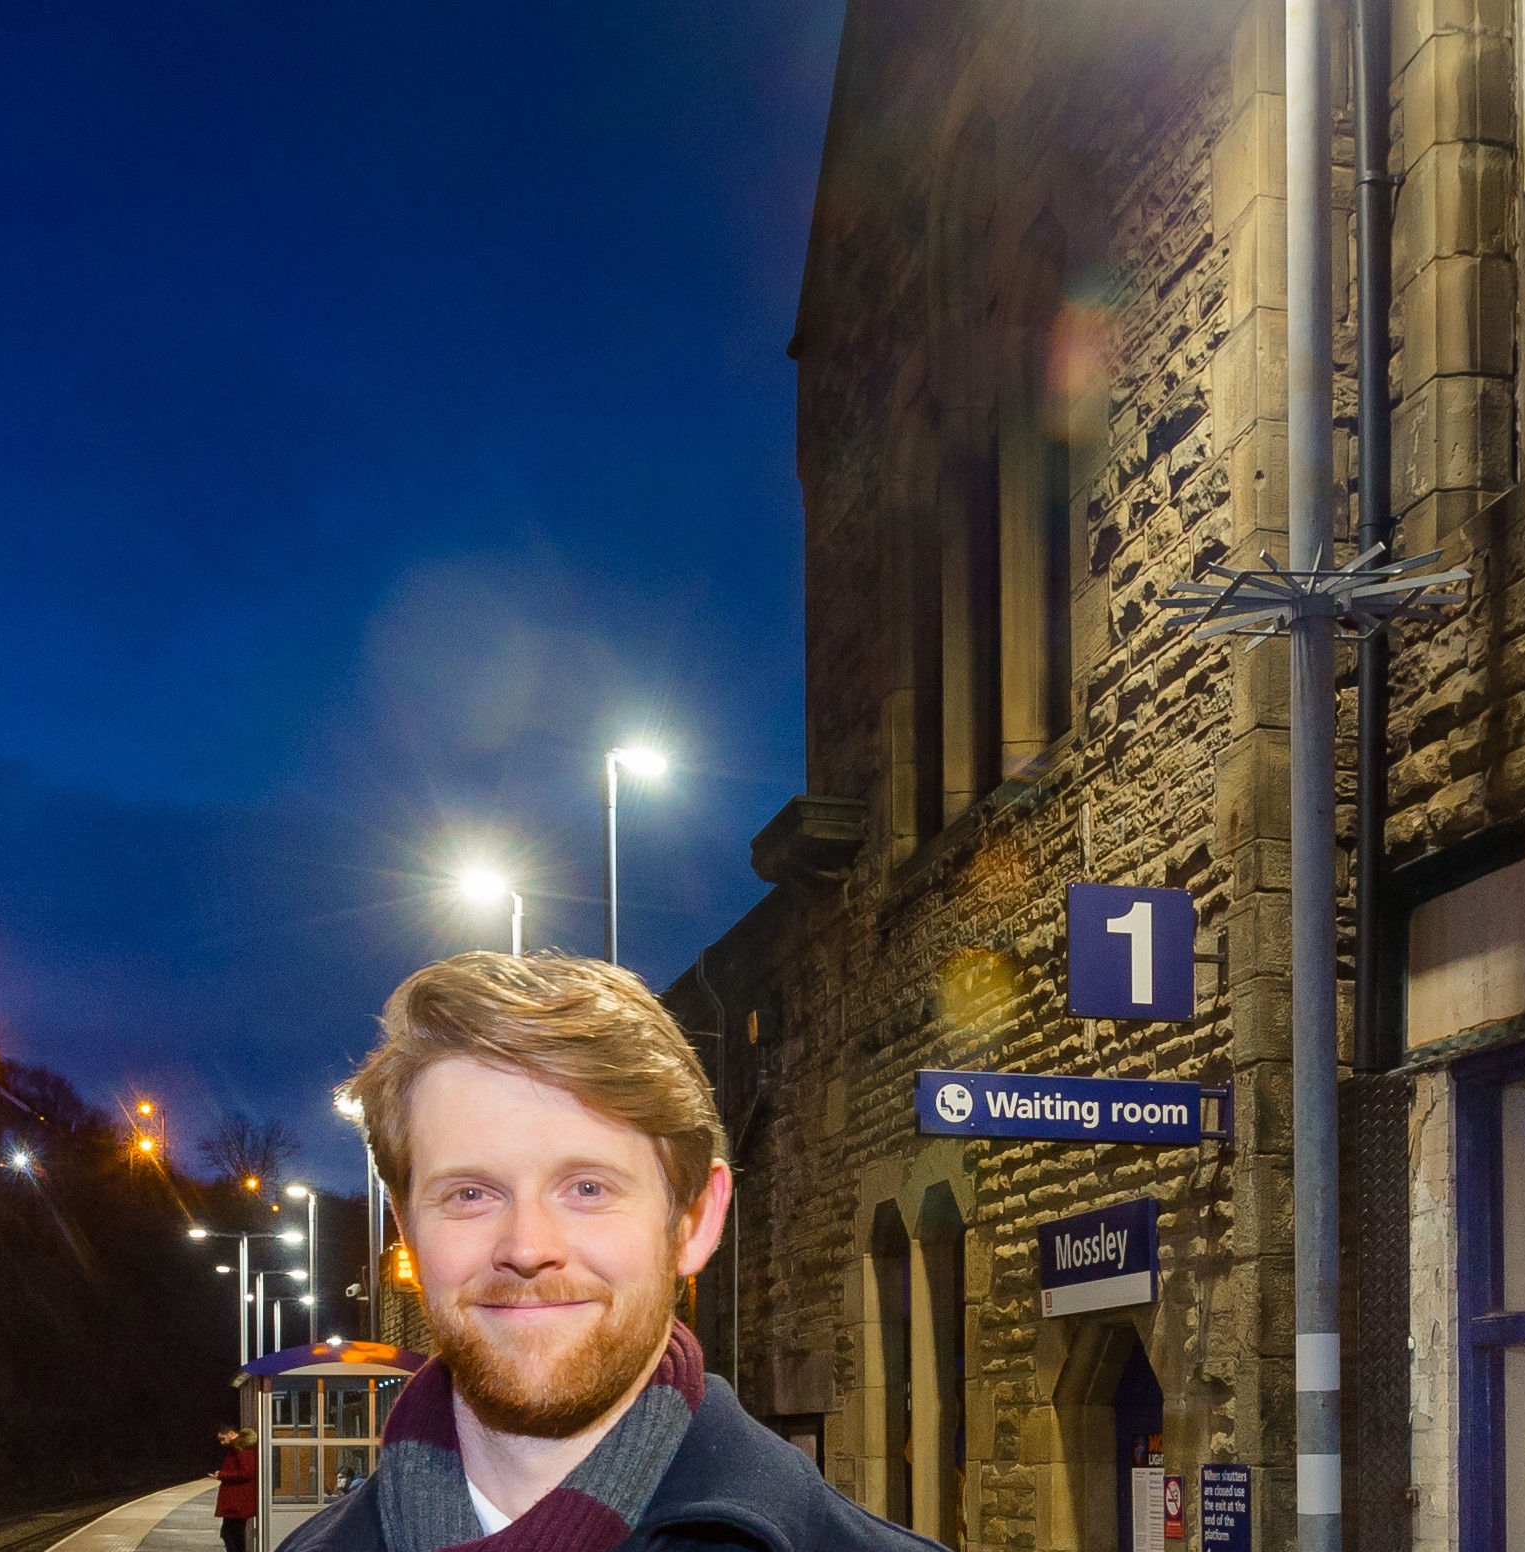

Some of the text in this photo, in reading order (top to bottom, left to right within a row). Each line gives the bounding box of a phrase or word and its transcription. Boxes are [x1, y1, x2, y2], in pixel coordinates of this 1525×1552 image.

[1106, 901, 1153, 1004] 1
[985, 1091, 1188, 1128] Waiting room
[1055, 1222, 1128, 1271] Mossley
[1204, 1470, 1220, 1481] When
[1204, 1484, 1245, 1497] are closed use
[1204, 1499, 1245, 1512] the exit at the
[1204, 1514, 1234, 1526] end of the
